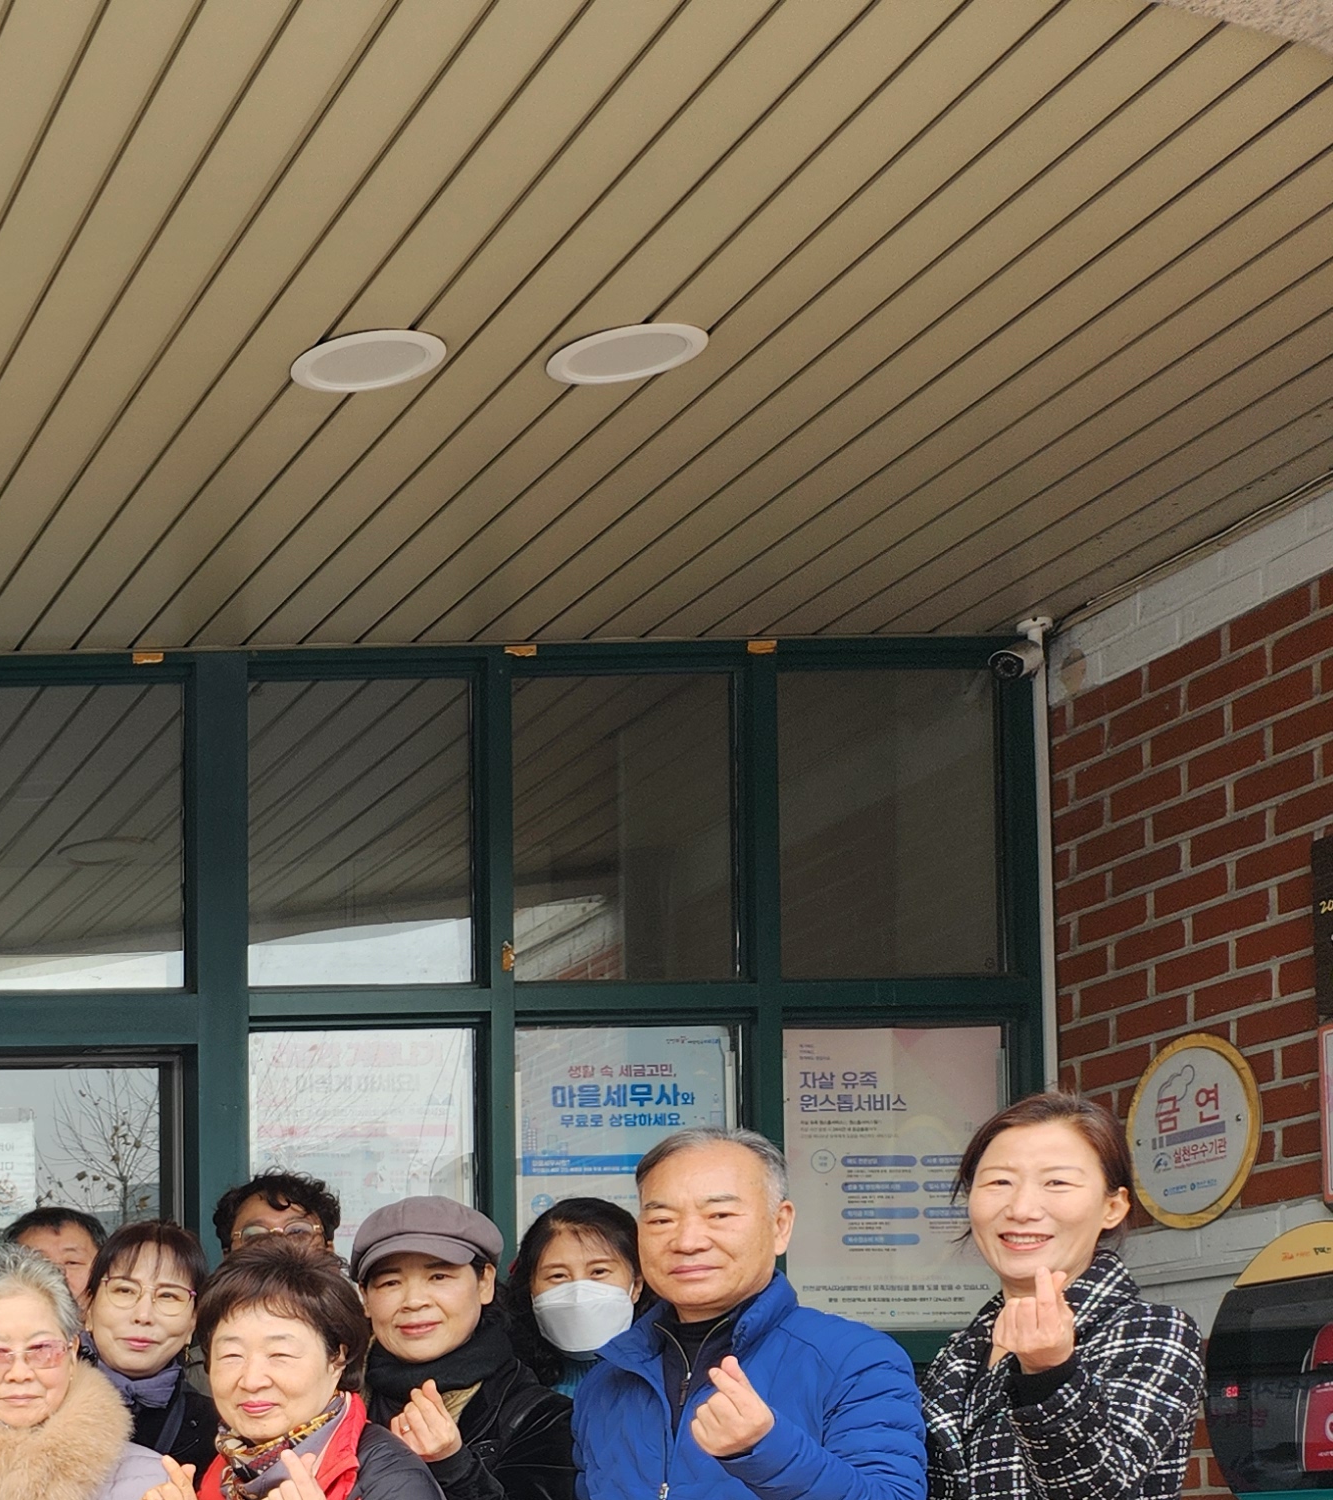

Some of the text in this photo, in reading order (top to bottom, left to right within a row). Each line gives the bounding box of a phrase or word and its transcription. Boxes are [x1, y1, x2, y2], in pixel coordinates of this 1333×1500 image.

[568, 1064, 677, 1079] 생활 속 세금고민,
[799, 1072, 878, 1090] 자살 유족
[551, 1083, 696, 1108] 마을세무사와
[800, 1094, 907, 1112] 원스톱서비스
[1155, 1083, 1220, 1134] 금연
[560, 1113, 685, 1128] 무료로 상담하세요.
[1173, 1137, 1227, 1165] 실천우수기관
